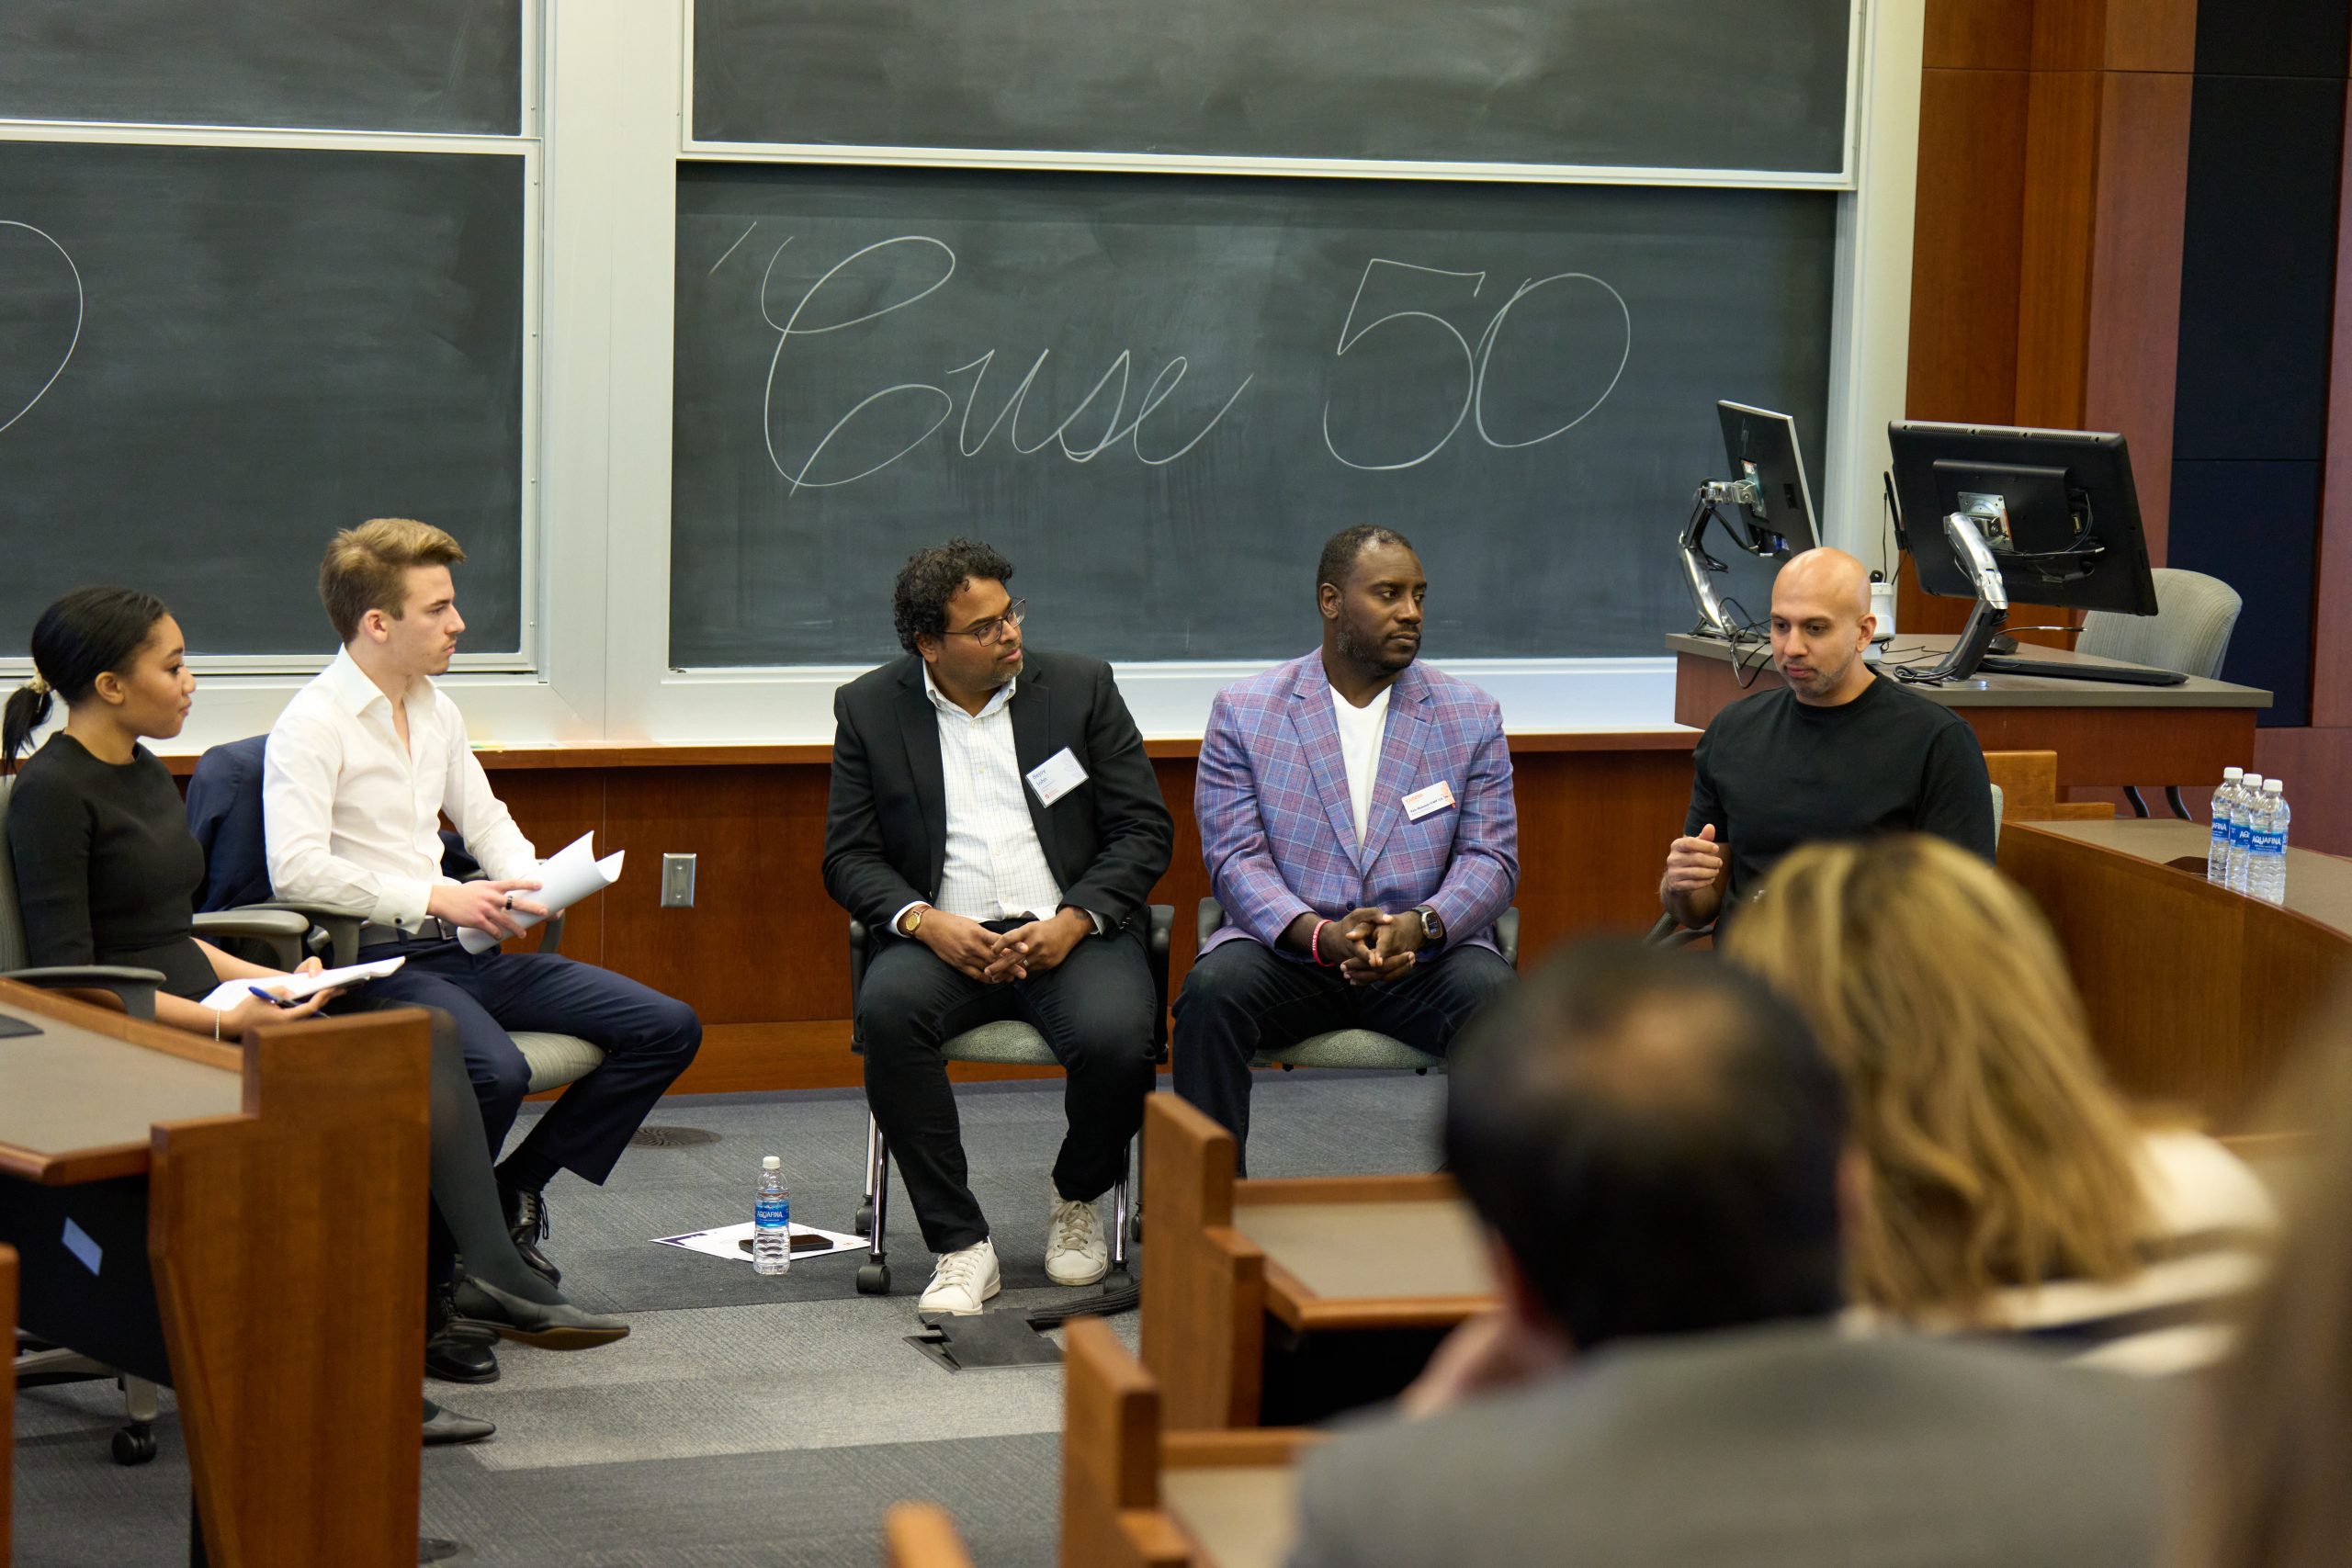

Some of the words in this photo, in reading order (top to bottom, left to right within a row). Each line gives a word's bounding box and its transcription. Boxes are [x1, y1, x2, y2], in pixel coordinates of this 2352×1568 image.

[1324, 258, 1631, 470] 50
[2252, 835, 2281, 846] AQUAFINA
[757, 1211, 783, 1219] AQUAFINA
